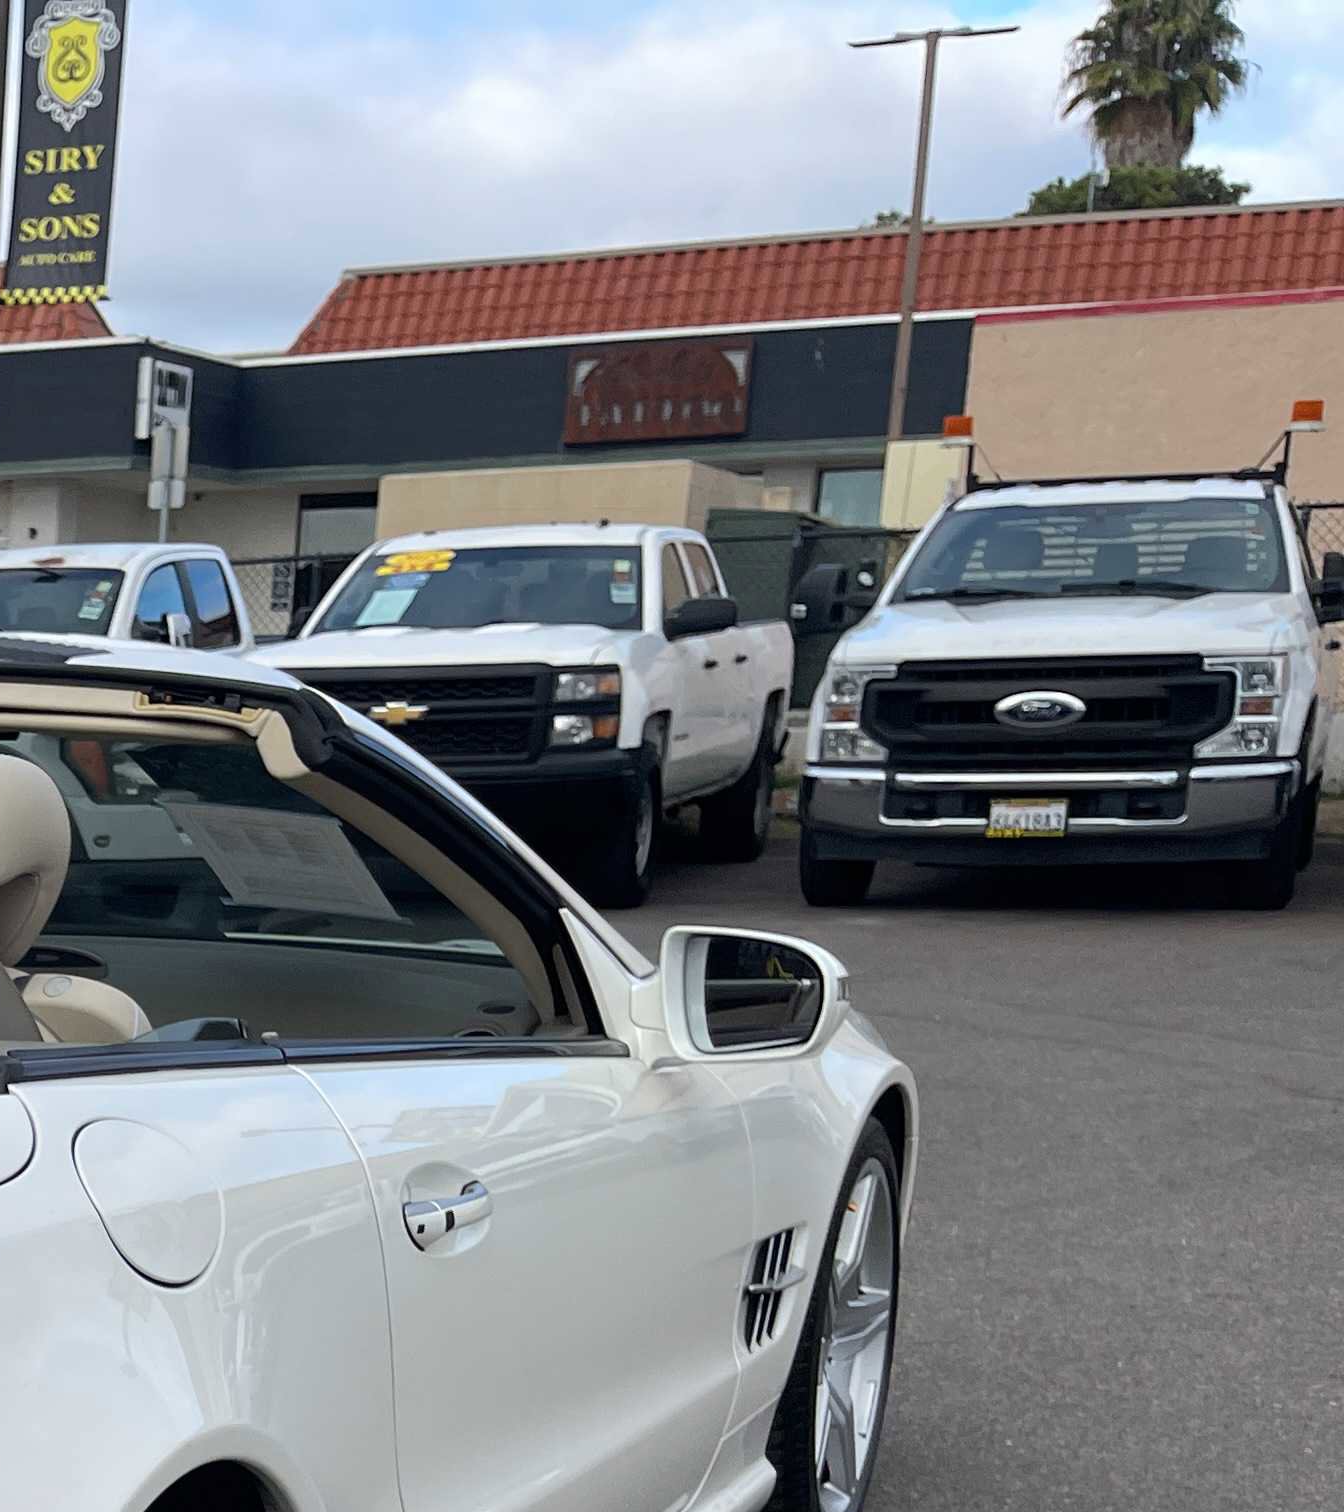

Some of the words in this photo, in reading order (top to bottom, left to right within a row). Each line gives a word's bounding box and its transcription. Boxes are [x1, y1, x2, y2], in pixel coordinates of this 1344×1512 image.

[23, 144, 105, 175] SIRY
[48, 182, 75, 205] &
[19, 213, 100, 242] SONS
